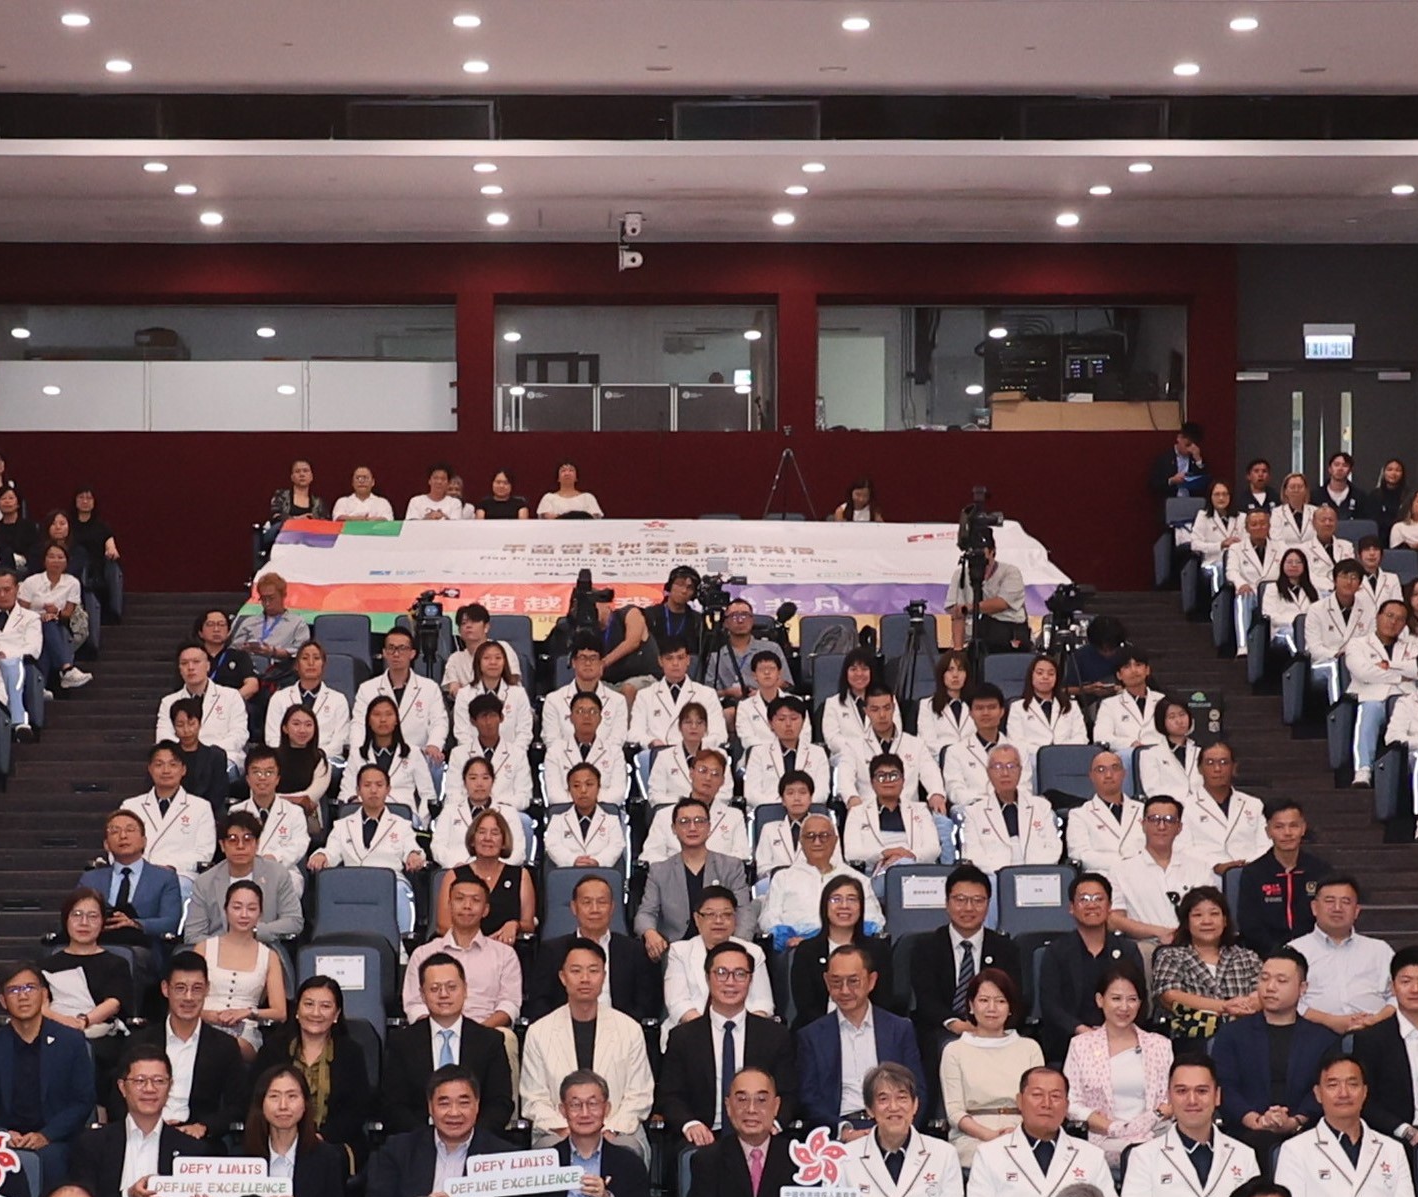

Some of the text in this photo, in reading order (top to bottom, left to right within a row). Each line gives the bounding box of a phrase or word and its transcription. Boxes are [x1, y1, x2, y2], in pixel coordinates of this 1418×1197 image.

[179, 1163, 262, 1175] DEFY LIMITS
[473, 1156, 555, 1173] DEFY LIMITS
[154, 1181, 287, 1194] DEFINE EXCELLENCE
[450, 1172, 580, 1194] DEFINE EXCELLENCE
